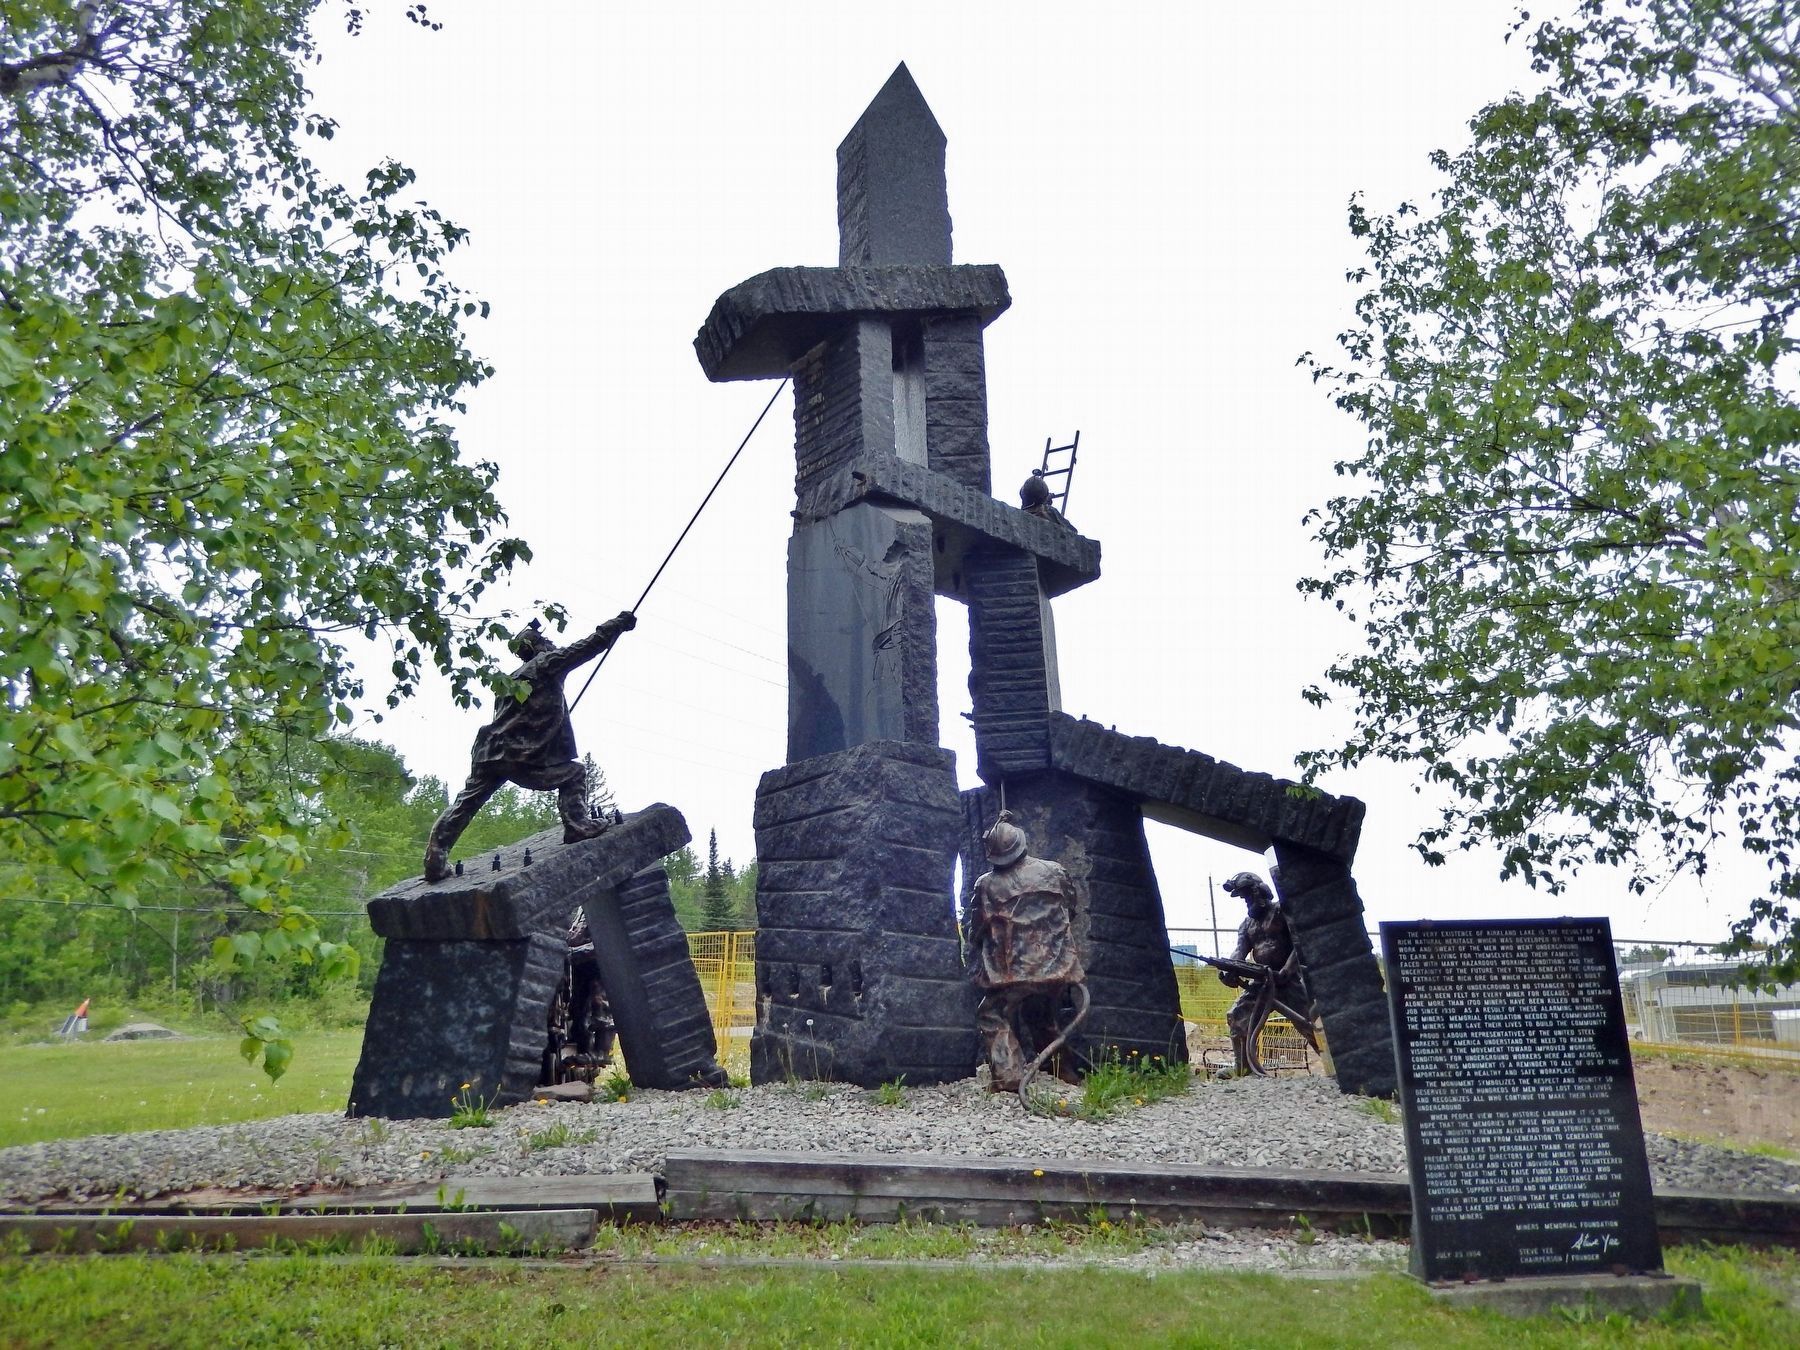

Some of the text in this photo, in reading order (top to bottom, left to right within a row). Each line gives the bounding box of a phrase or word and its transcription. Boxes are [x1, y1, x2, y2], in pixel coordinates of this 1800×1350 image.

[1466, 983, 1511, 991] UNDERGROUND
[1449, 1014, 1481, 1022] MEMORIAL
[1470, 1030, 1526, 1038] REPRESENTATIVES
[1410, 1047, 1443, 1055] VISIONARY
[1535, 1044, 1566, 1052] IMPROVED
[1465, 1053, 1509, 1061] UNDERGROUND
[1446, 1062, 1460, 1070] THIS
[1516, 1060, 1547, 1068] REMINDER
[1474, 1069, 1501, 1077] HEALTHY
[1440, 1079, 1474, 1087] MONUMENT
[1478, 1078, 1516, 1086] SYMBOLIZES
[1476, 1086, 1509, 1094] HUNDREDS
[1419, 1121, 1435, 1129] HOPE
[1493, 1135, 1511, 1143] FROM
[1514, 1134, 1552, 1142] GENERATION
[1446, 1146, 1469, 1154] WOULD
[1541, 1143, 1561, 1151] THANK
[1511, 1168, 1529, 1176] RAISE
[1485, 1203, 1500, 1211] NOW
